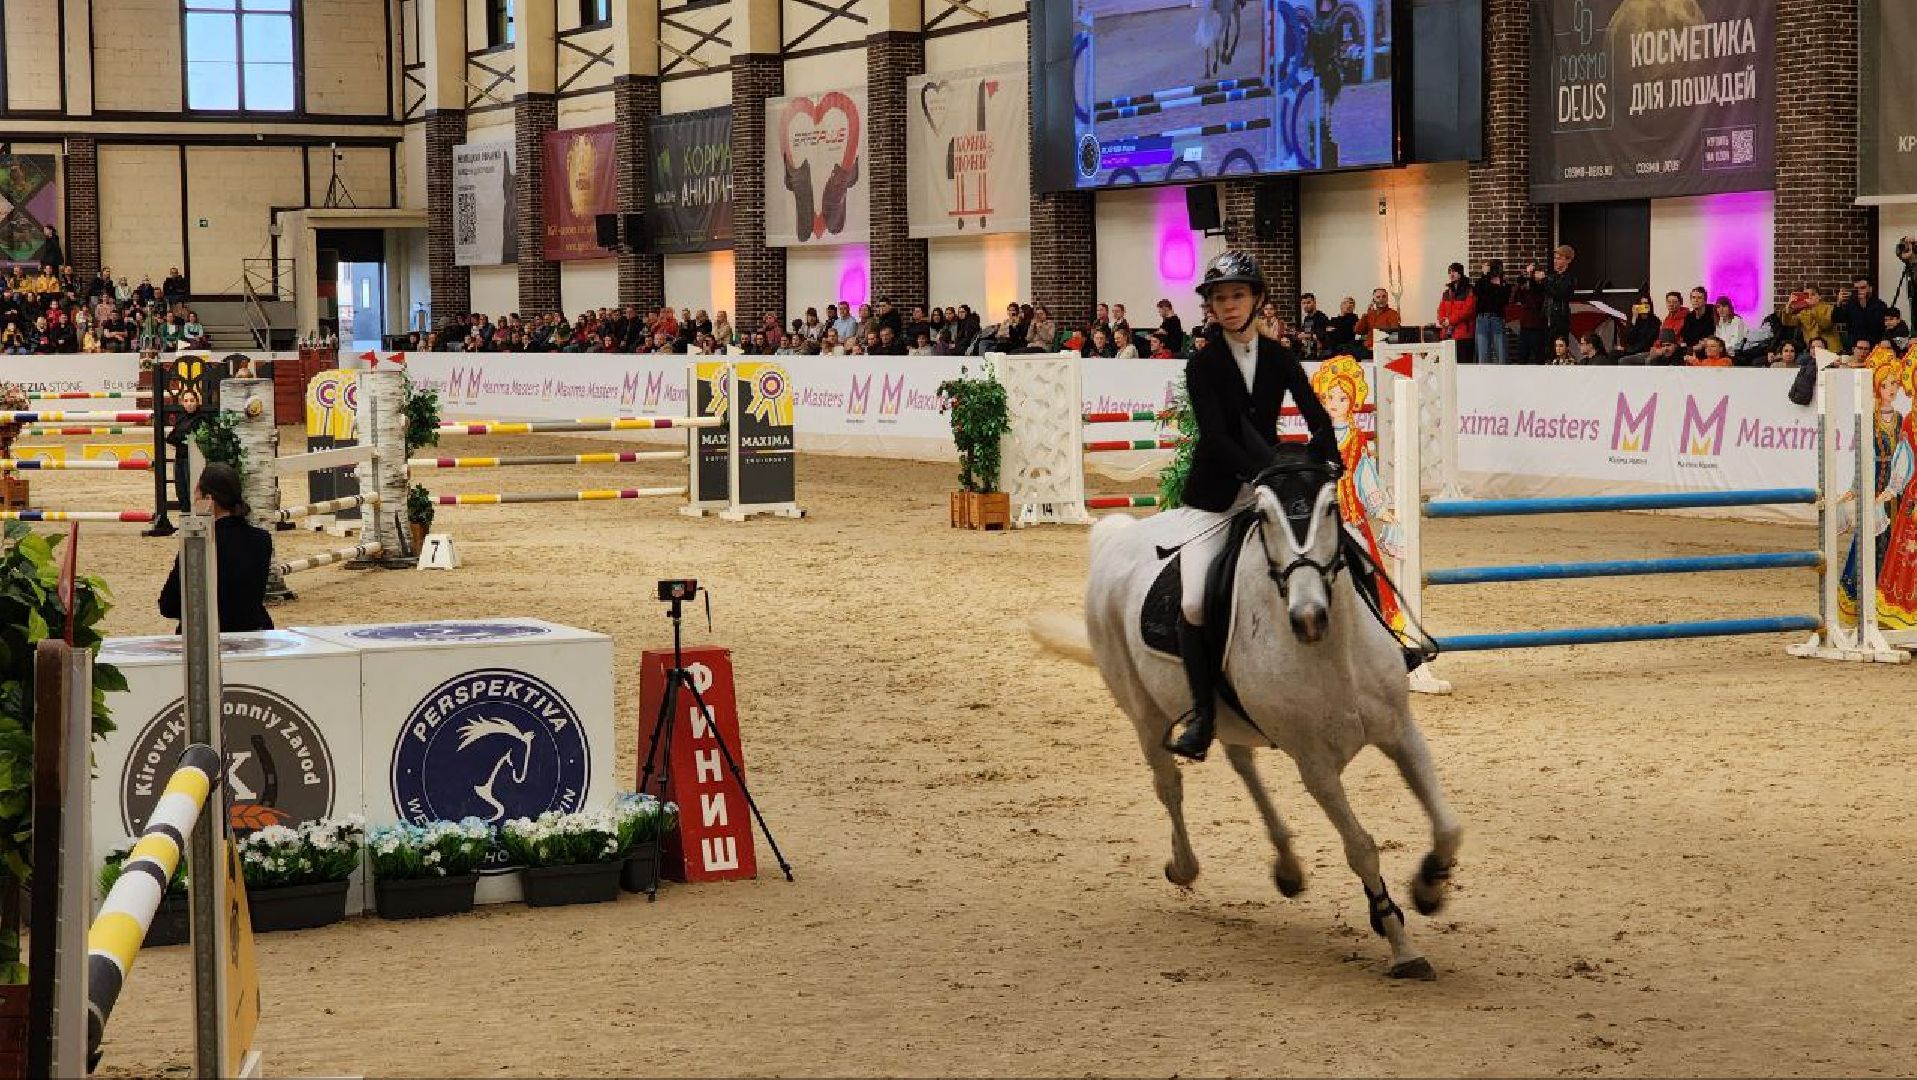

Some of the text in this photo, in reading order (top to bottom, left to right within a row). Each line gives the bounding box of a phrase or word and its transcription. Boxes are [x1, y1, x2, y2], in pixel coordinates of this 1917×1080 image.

[1630, 19, 1756, 68] КОСМЕТИКА
[1560, 52, 1606, 82] COSMO
[1558, 82, 1607, 122] DEUS
[1629, 64, 1756, 115] ДЛЯ ЛОШАДЕЙ
[682, 143, 733, 176] КОРМА
[741, 434, 791, 447] MAXIMA
[1458, 407, 1600, 441] xima Masters
[430, 539, 441, 564] 7
[413, 679, 568, 743] PERSPEKTIVA
[222, 700, 282, 728] onniy
[280, 722, 321, 785] Zavod
[683, 661, 739, 872] ФИНИШ
